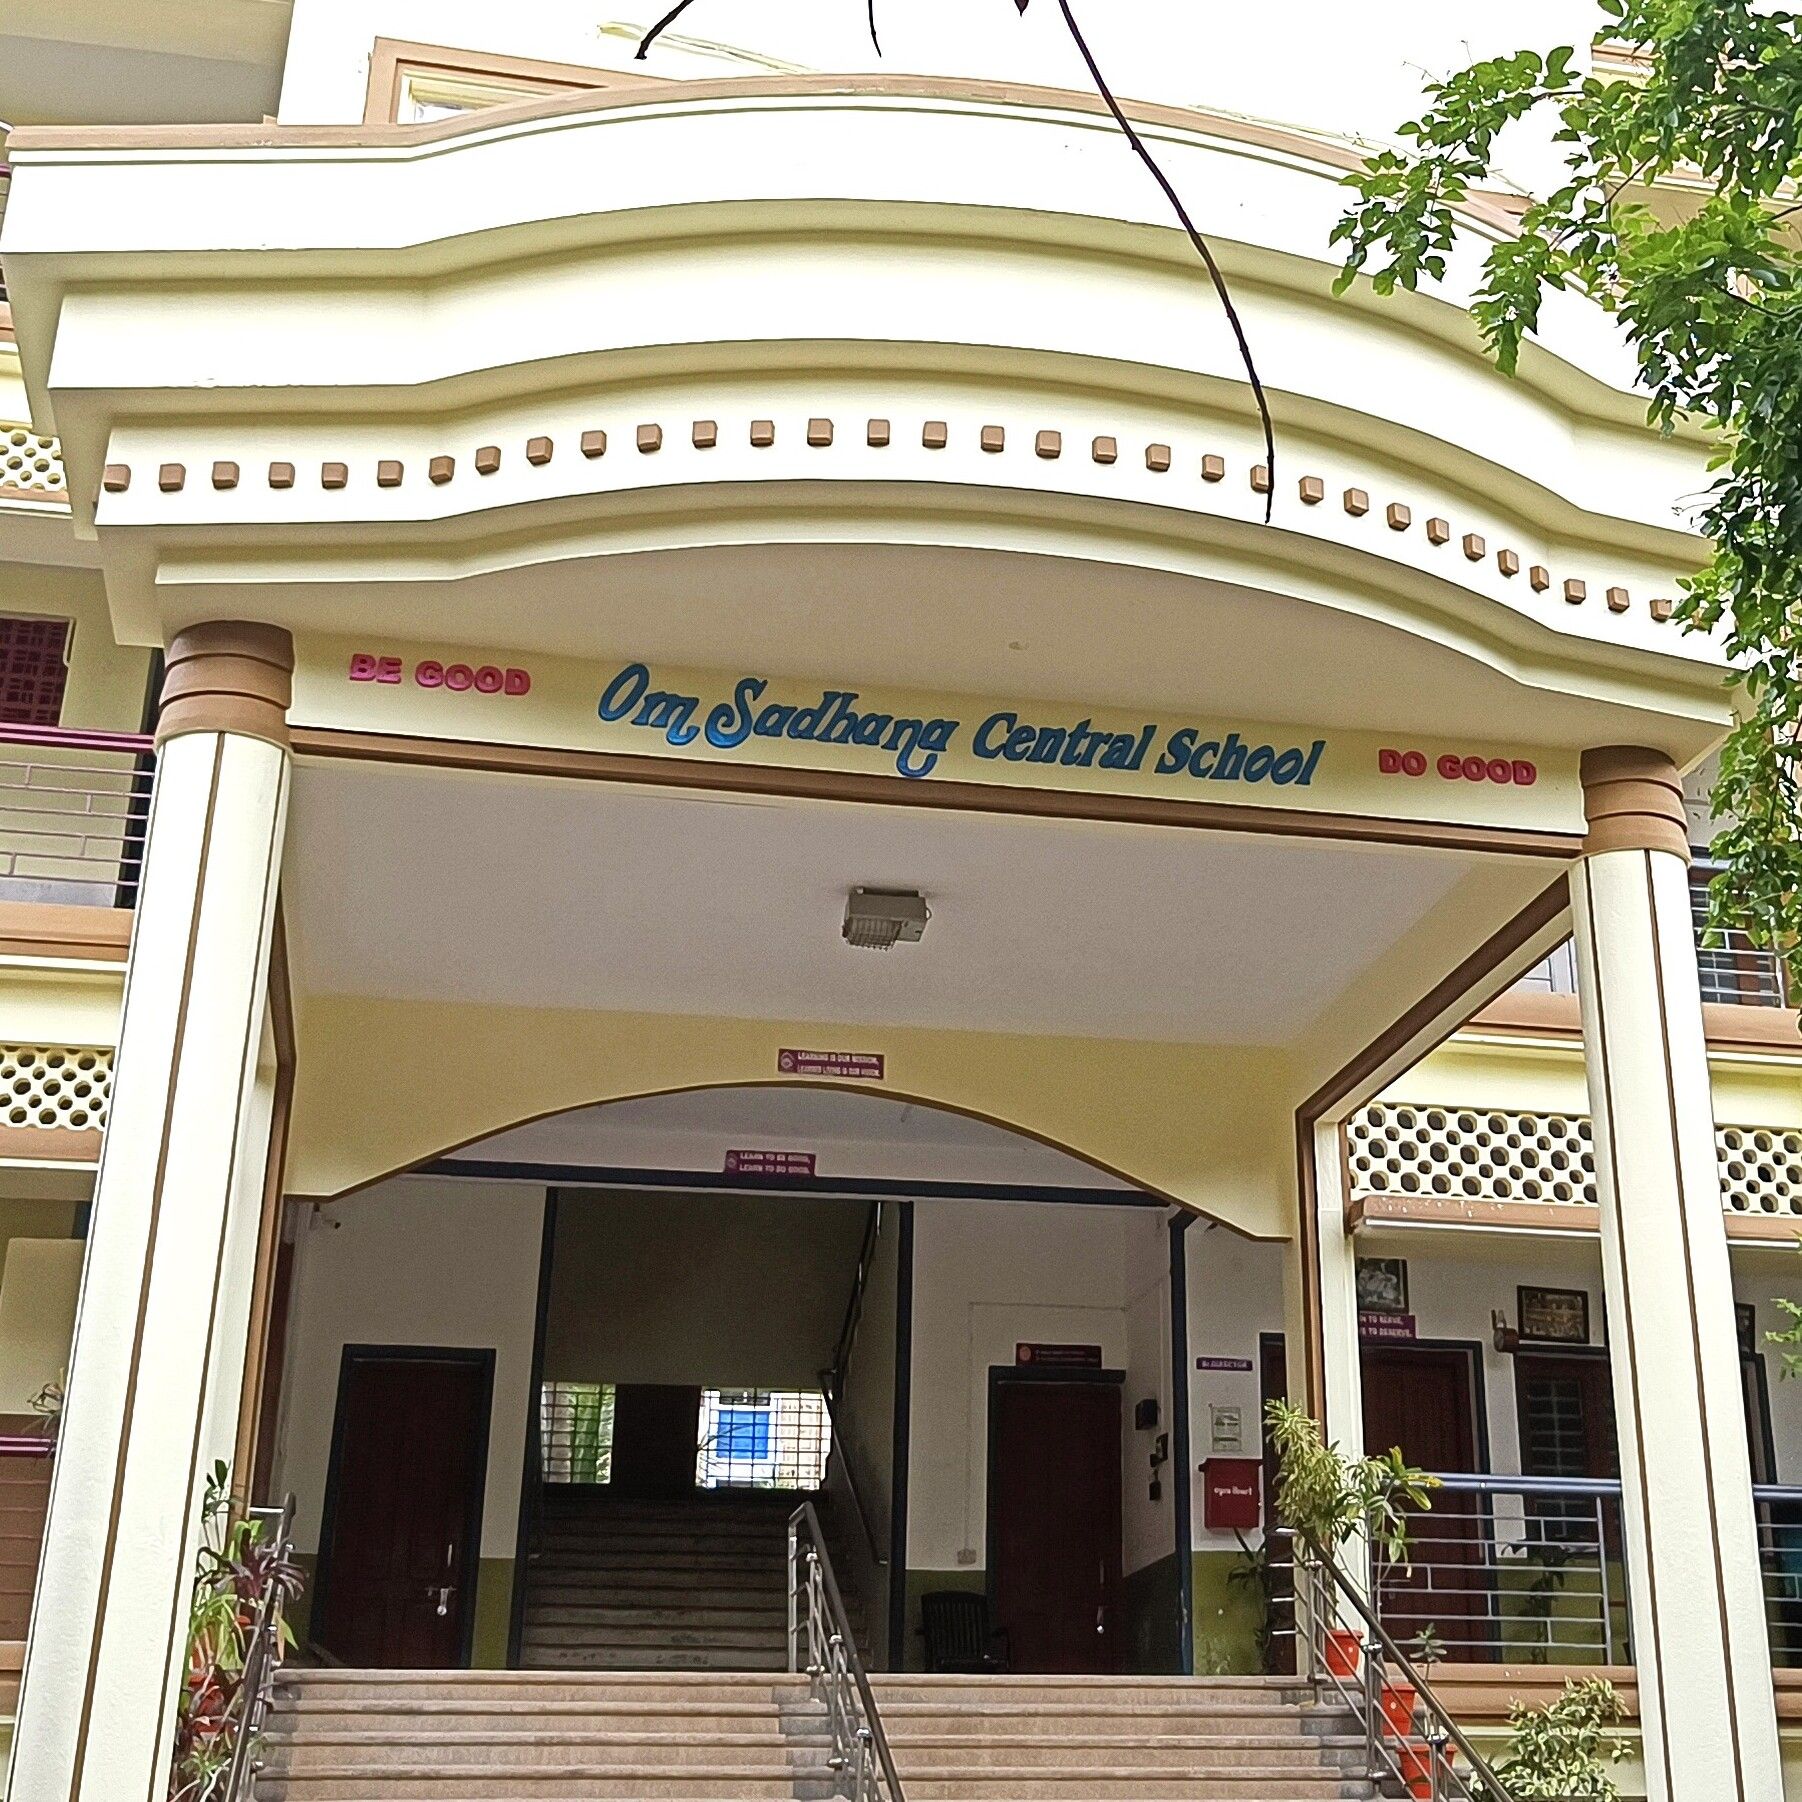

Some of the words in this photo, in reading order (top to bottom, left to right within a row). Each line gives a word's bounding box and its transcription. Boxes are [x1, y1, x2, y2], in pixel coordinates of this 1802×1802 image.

[350, 653, 401, 684] BE
[415, 660, 532, 696] GOOD
[598, 663, 700, 746] Om
[704, 677, 959, 778] Sadhana
[972, 712, 1158, 769] Central
[1155, 727, 1327, 786] School
[1379, 748, 1427, 776] DO
[1437, 756, 1538, 785] GOOD
